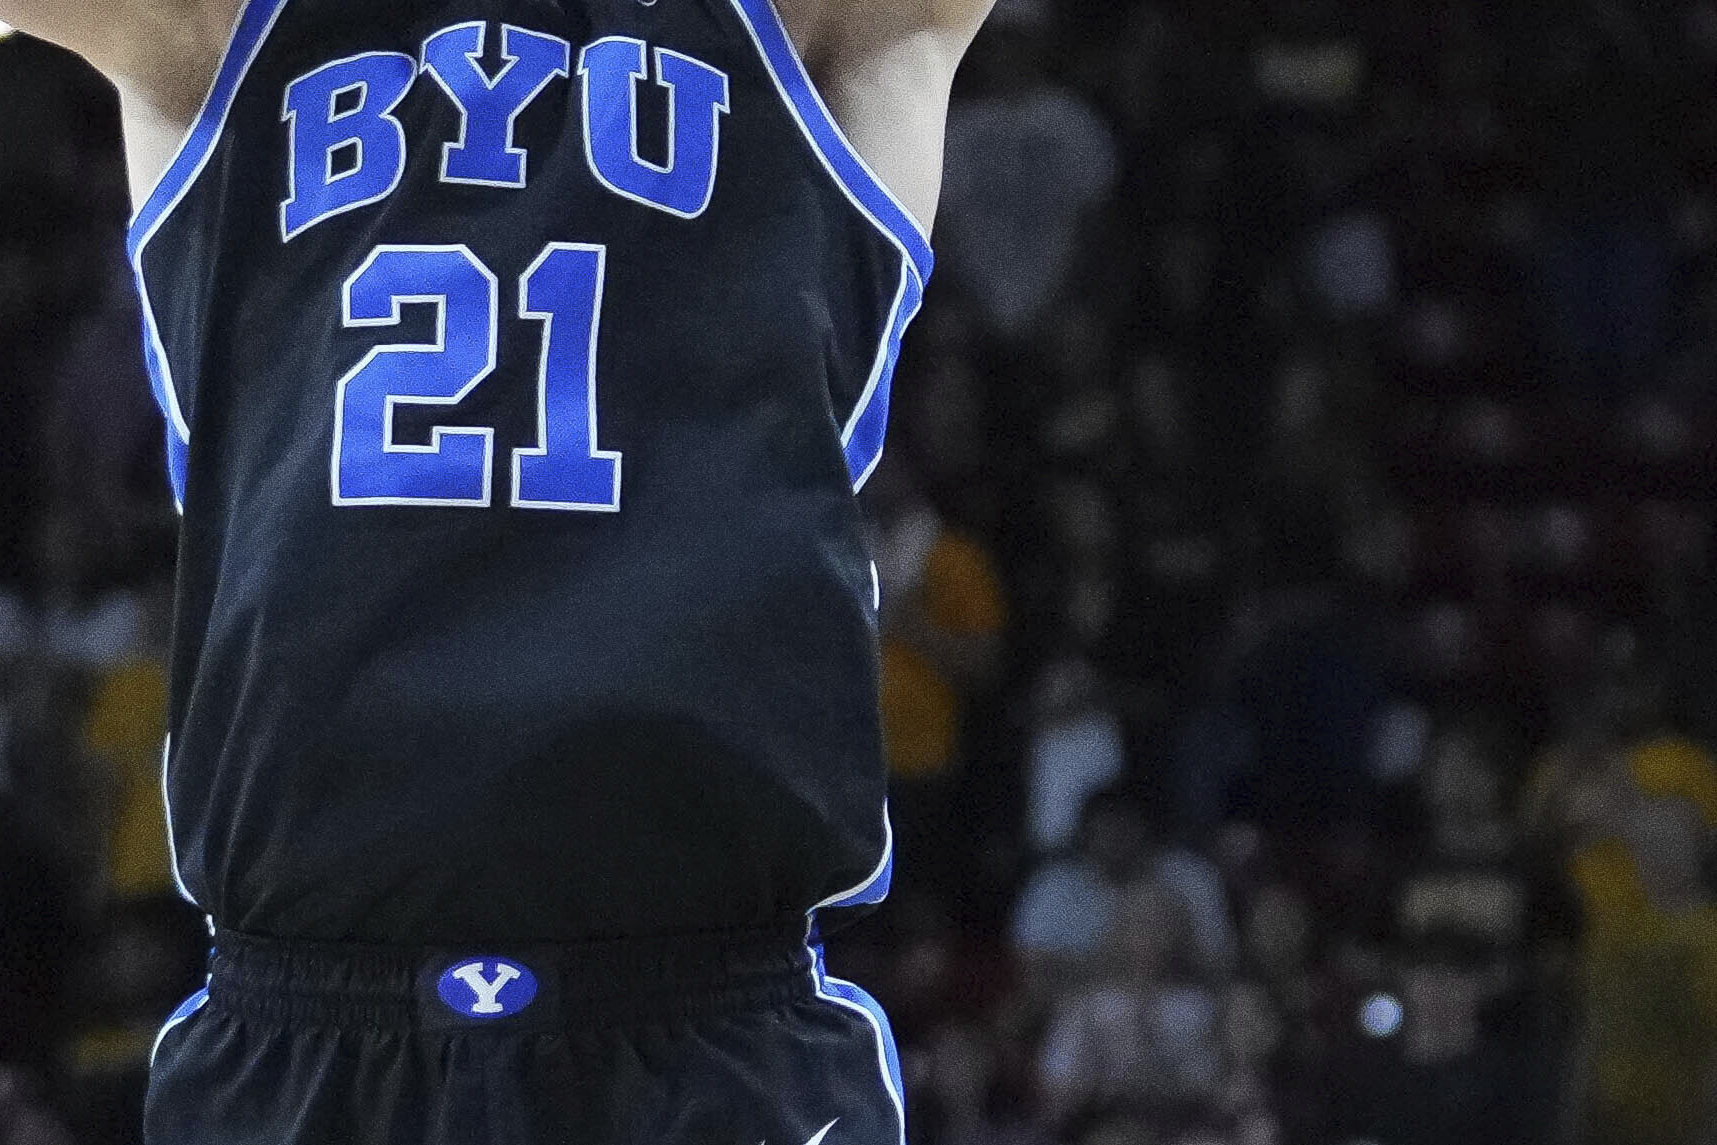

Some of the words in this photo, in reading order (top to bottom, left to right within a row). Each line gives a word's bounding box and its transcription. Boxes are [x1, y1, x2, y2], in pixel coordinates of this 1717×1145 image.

[280, 21, 730, 243] BYU
[332, 242, 623, 512] 21
[452, 962, 521, 1013] Y
